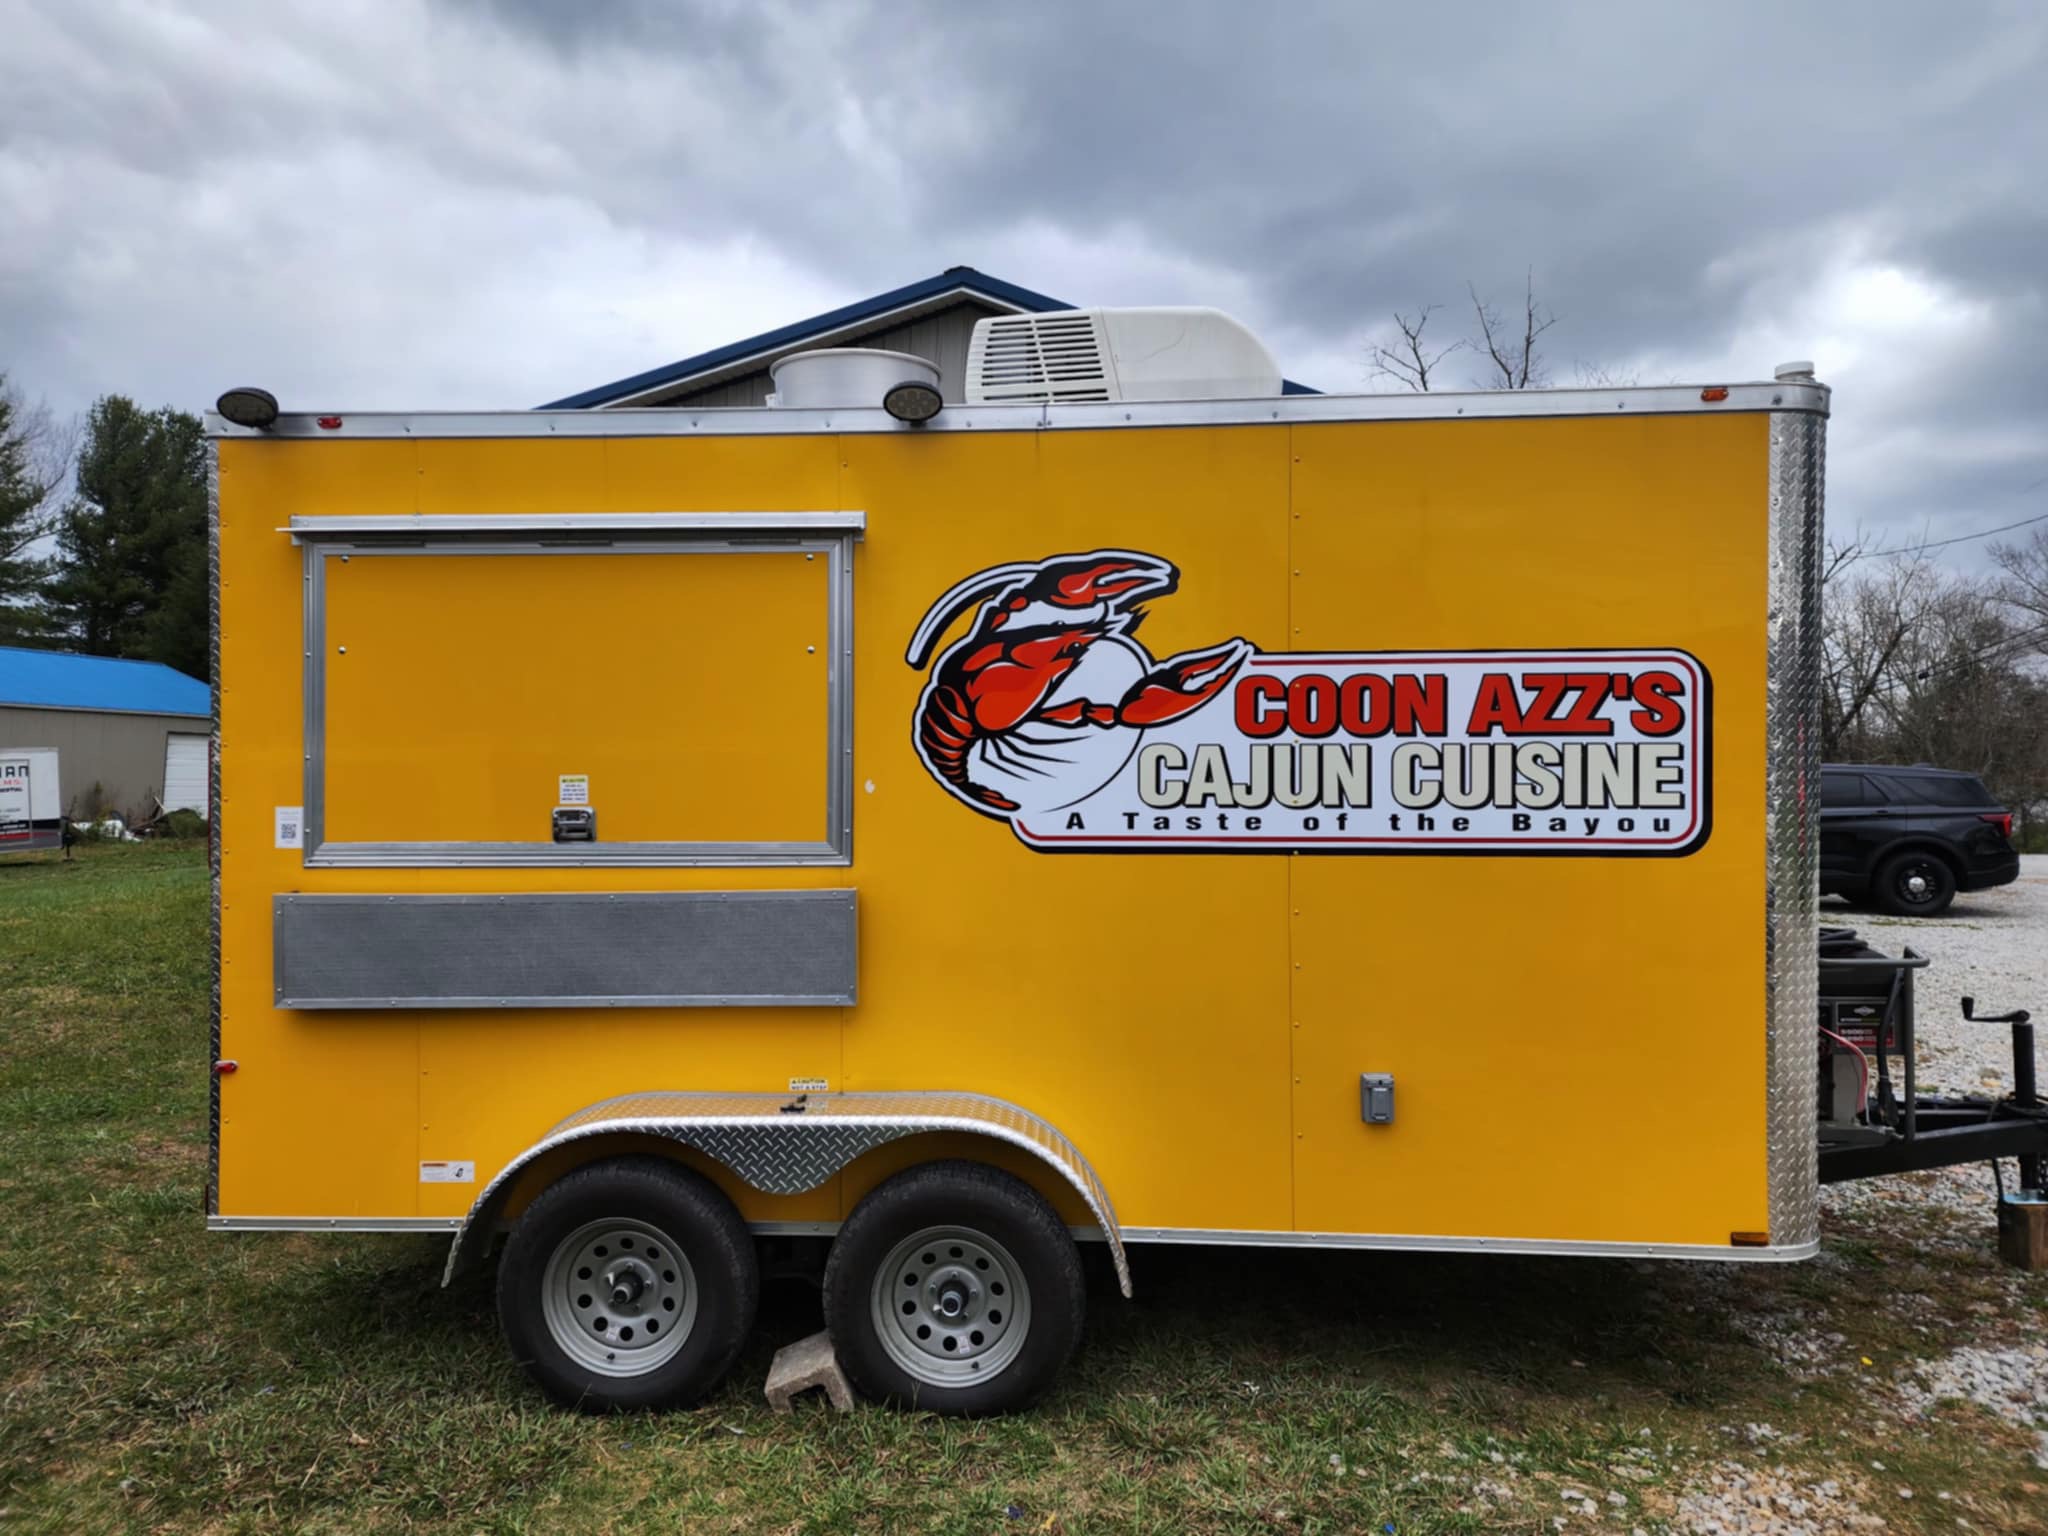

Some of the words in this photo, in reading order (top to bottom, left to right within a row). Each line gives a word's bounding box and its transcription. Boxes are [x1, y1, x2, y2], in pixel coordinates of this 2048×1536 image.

[1234, 673, 1448, 738] COON
[1465, 670, 1686, 738] AZZ'S
[1137, 742, 1372, 810] CAJUN
[1391, 741, 1686, 810] CUISINE
[1066, 812, 1085, 830] A
[1122, 812, 1262, 831] Taste
[1303, 812, 1348, 831] of
[1389, 813, 1470, 831] the
[1512, 813, 1670, 836] Bayou
